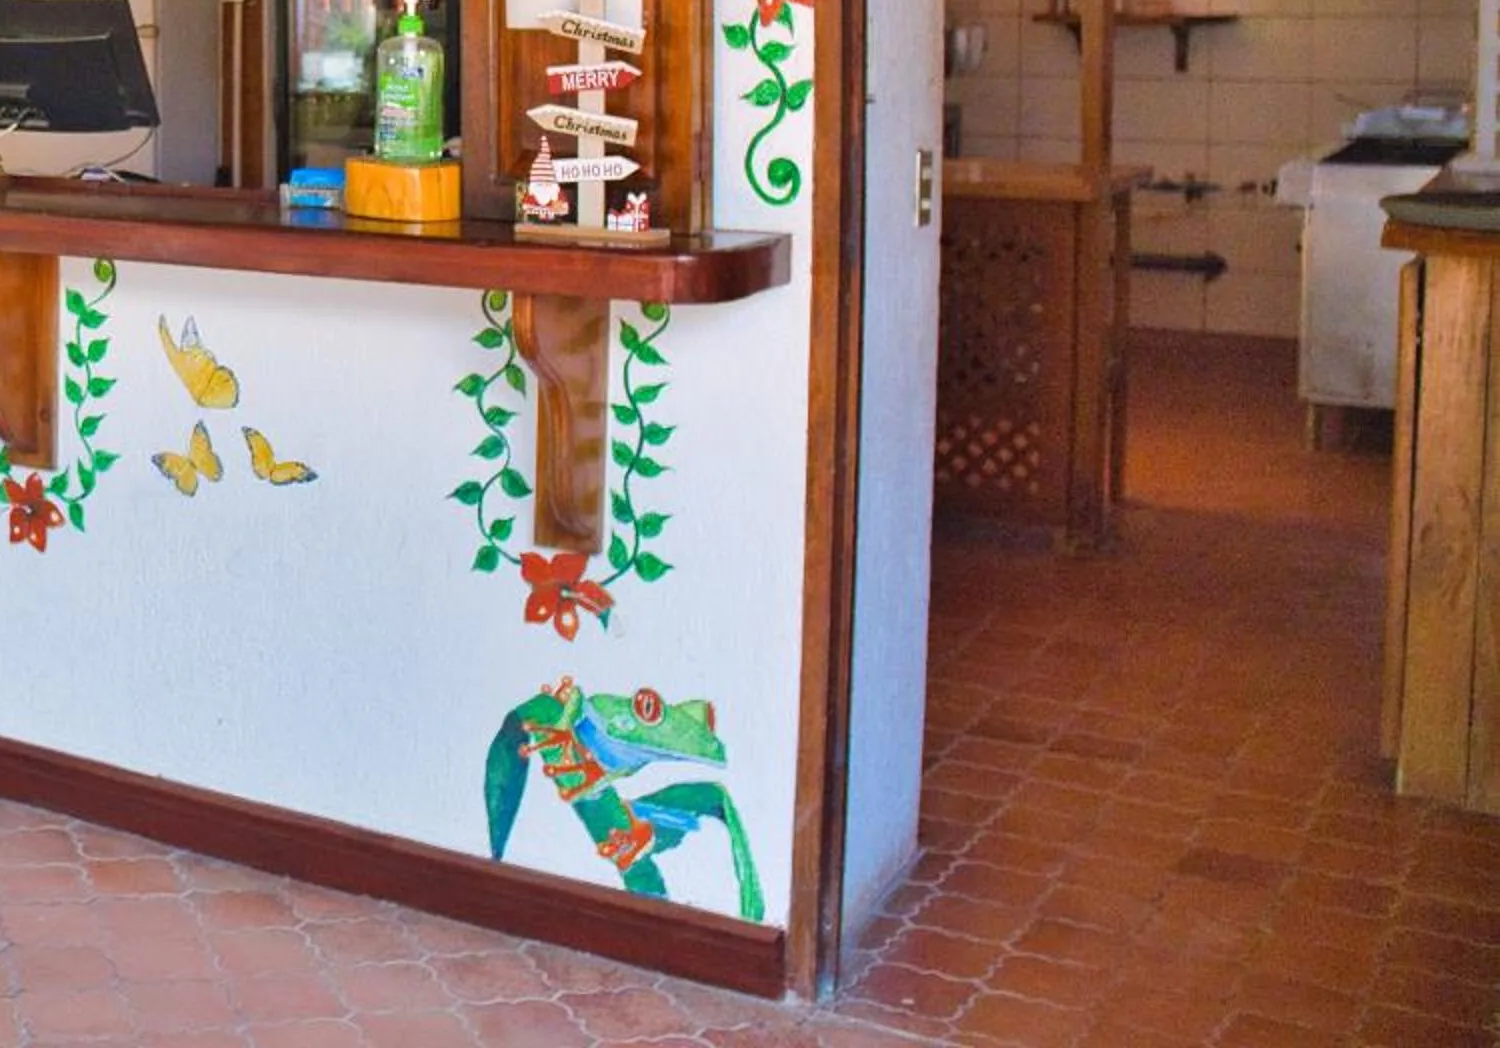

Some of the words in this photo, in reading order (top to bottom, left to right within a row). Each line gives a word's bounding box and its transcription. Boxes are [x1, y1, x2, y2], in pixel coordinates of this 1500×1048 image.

[561, 18, 635, 48] Christmas
[562, 71, 620, 91] MERRY
[553, 114, 628, 141] Christmas
[561, 165, 581, 179] HO
[582, 164, 601, 178] HO
[603, 164, 623, 177] HO
